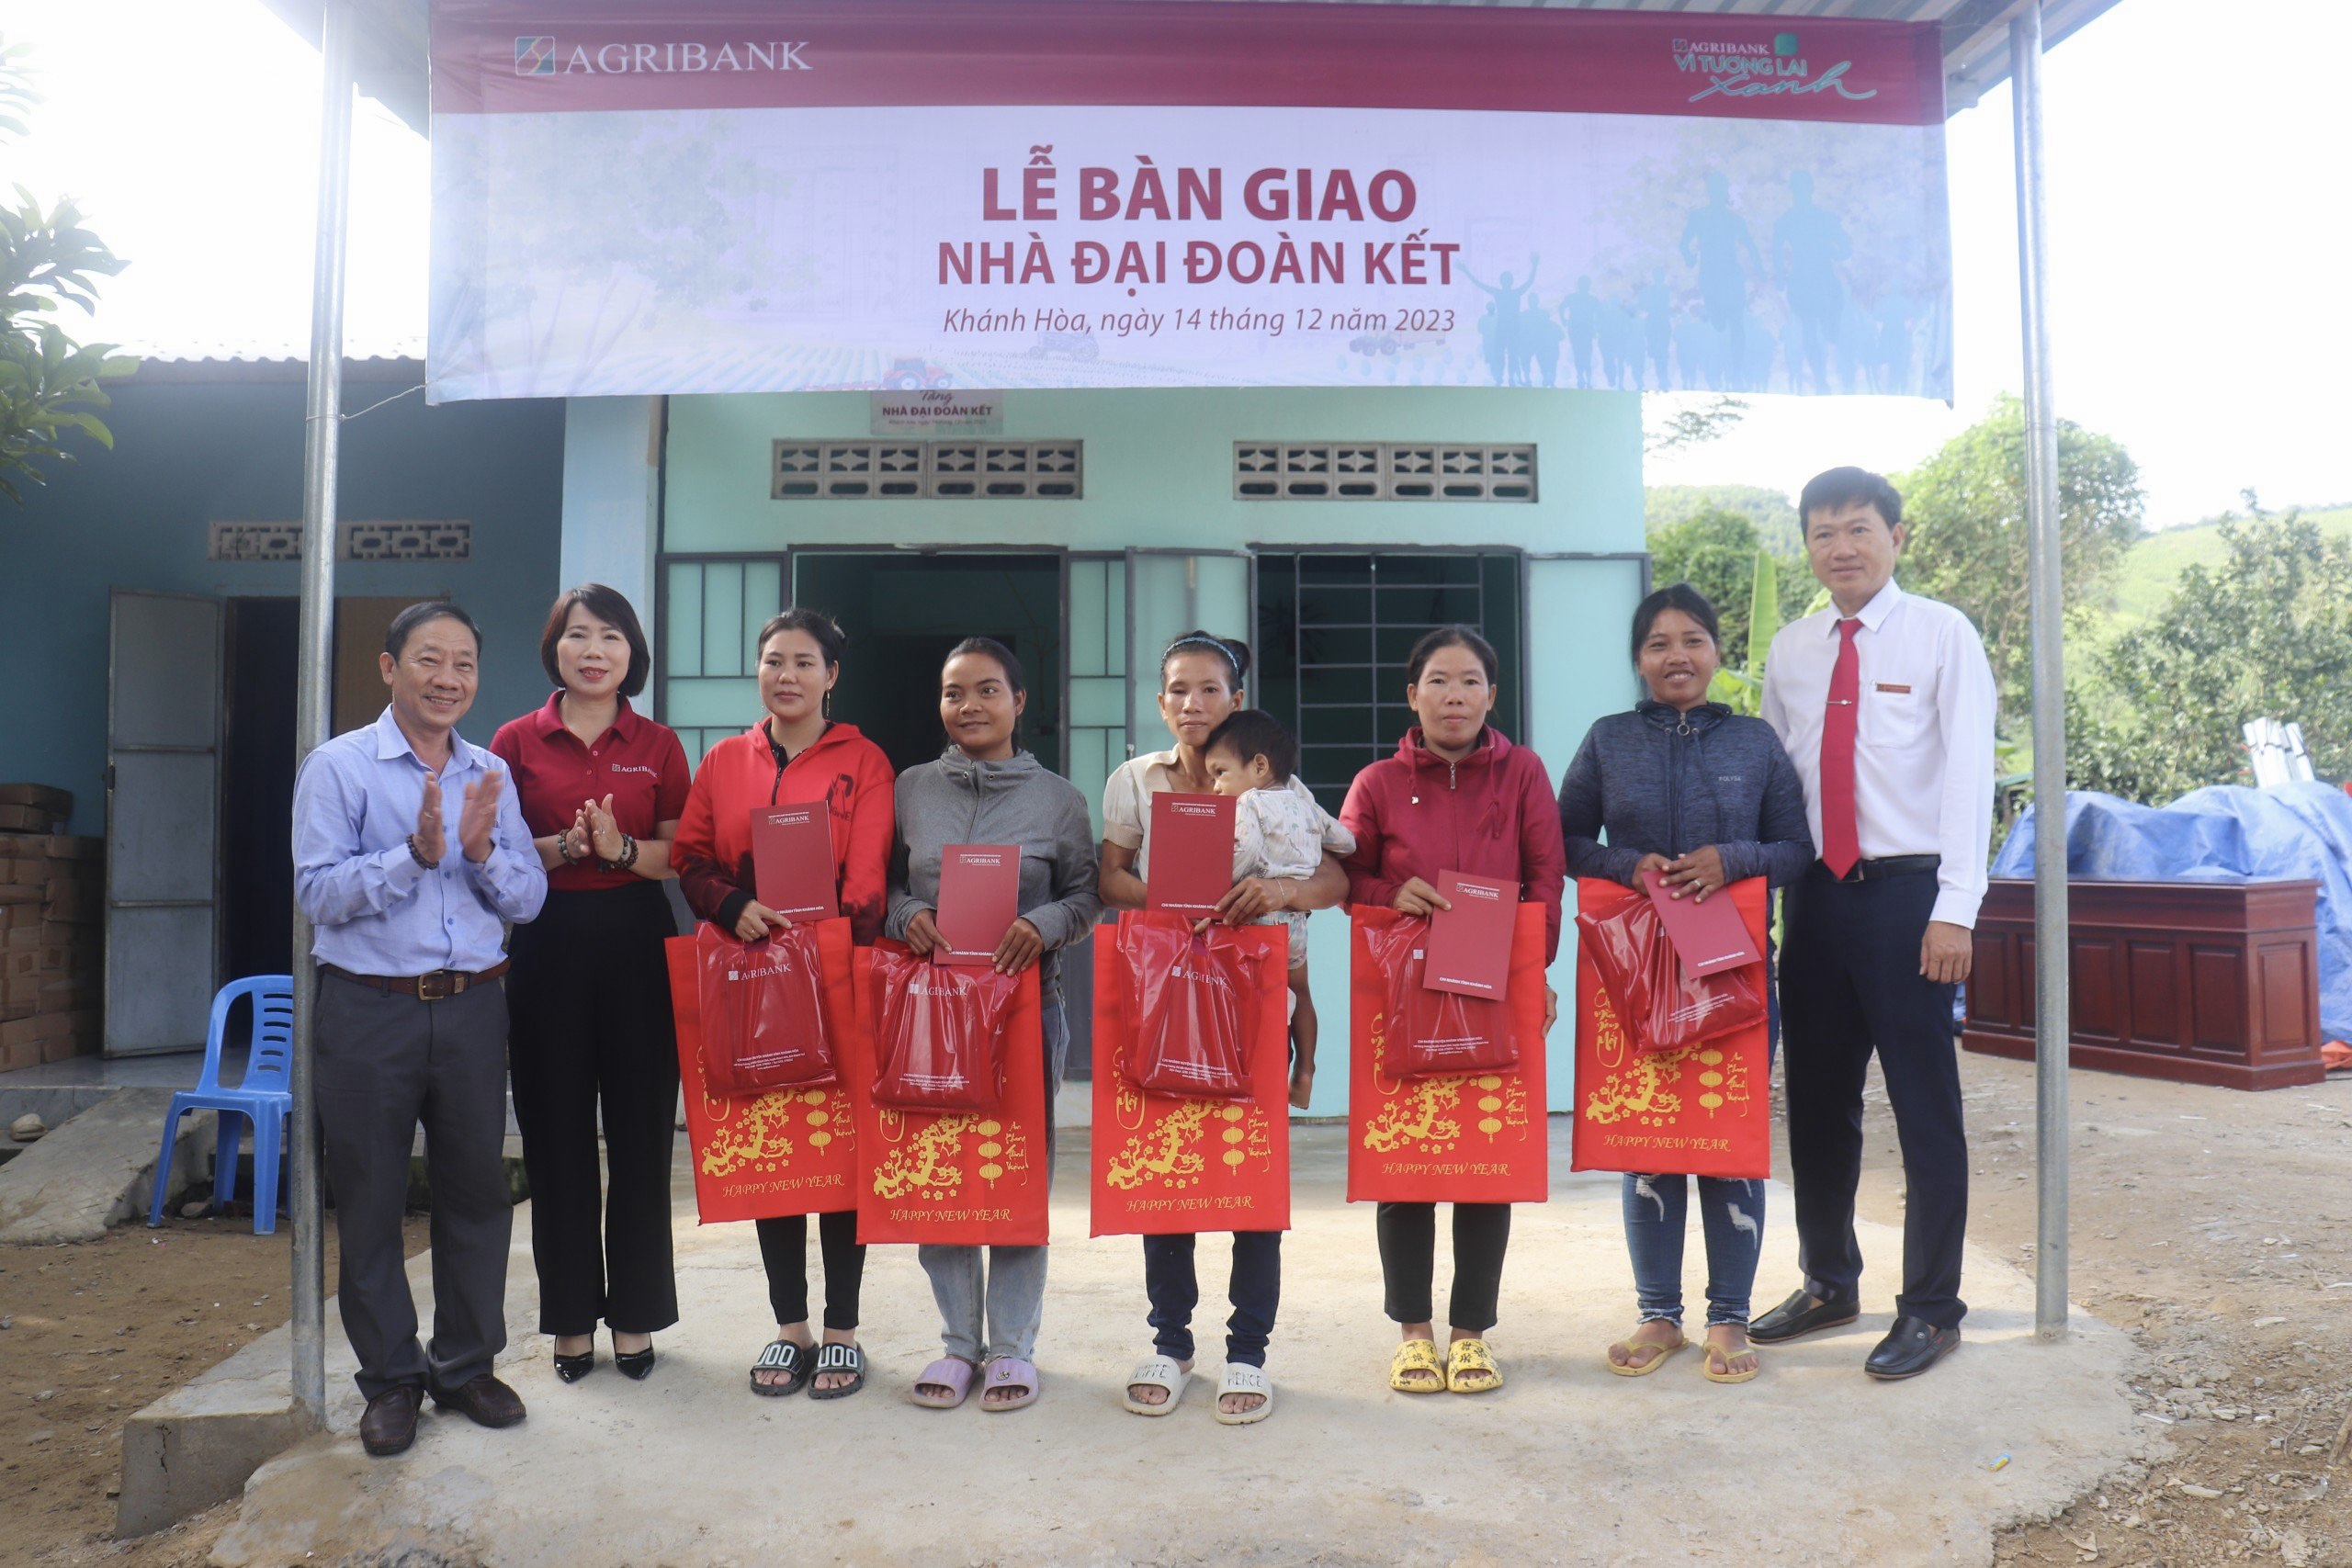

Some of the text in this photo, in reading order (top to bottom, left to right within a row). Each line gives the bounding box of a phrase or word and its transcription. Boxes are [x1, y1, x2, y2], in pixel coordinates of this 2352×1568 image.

[1690, 41, 1770, 54] AGRIBANK
[563, 41, 814, 74] AGRIBANK
[1776, 57, 1808, 77] LAI
[983, 144, 1417, 222] LỄ BÀN GIAO
[939, 228, 1461, 298] NHÀ ĐẠI ĐOÀN KẾT
[943, 306, 1456, 337] Khánh Hòa, ngày 14 tháng 12 năm 2023
[882, 403, 993, 418] NHÀ ĐẠI ĐOÀN KẾT
[775, 815, 809, 824] AGRIBANK
[1464, 887, 1499, 898] AGRIBANK
[741, 963, 792, 981] ARIBANK
[1603, 1134, 1732, 1153] HAPPY NEW YEAR
[1382, 1162, 1511, 1177] HAPPY NEW YEAR
[723, 1173, 845, 1198] HAPPY NEW YEAR
[1125, 1195, 1255, 1213] HAPPY NEW YEAR
[889, 1208, 1013, 1223] HAPPY NEW YEAR
